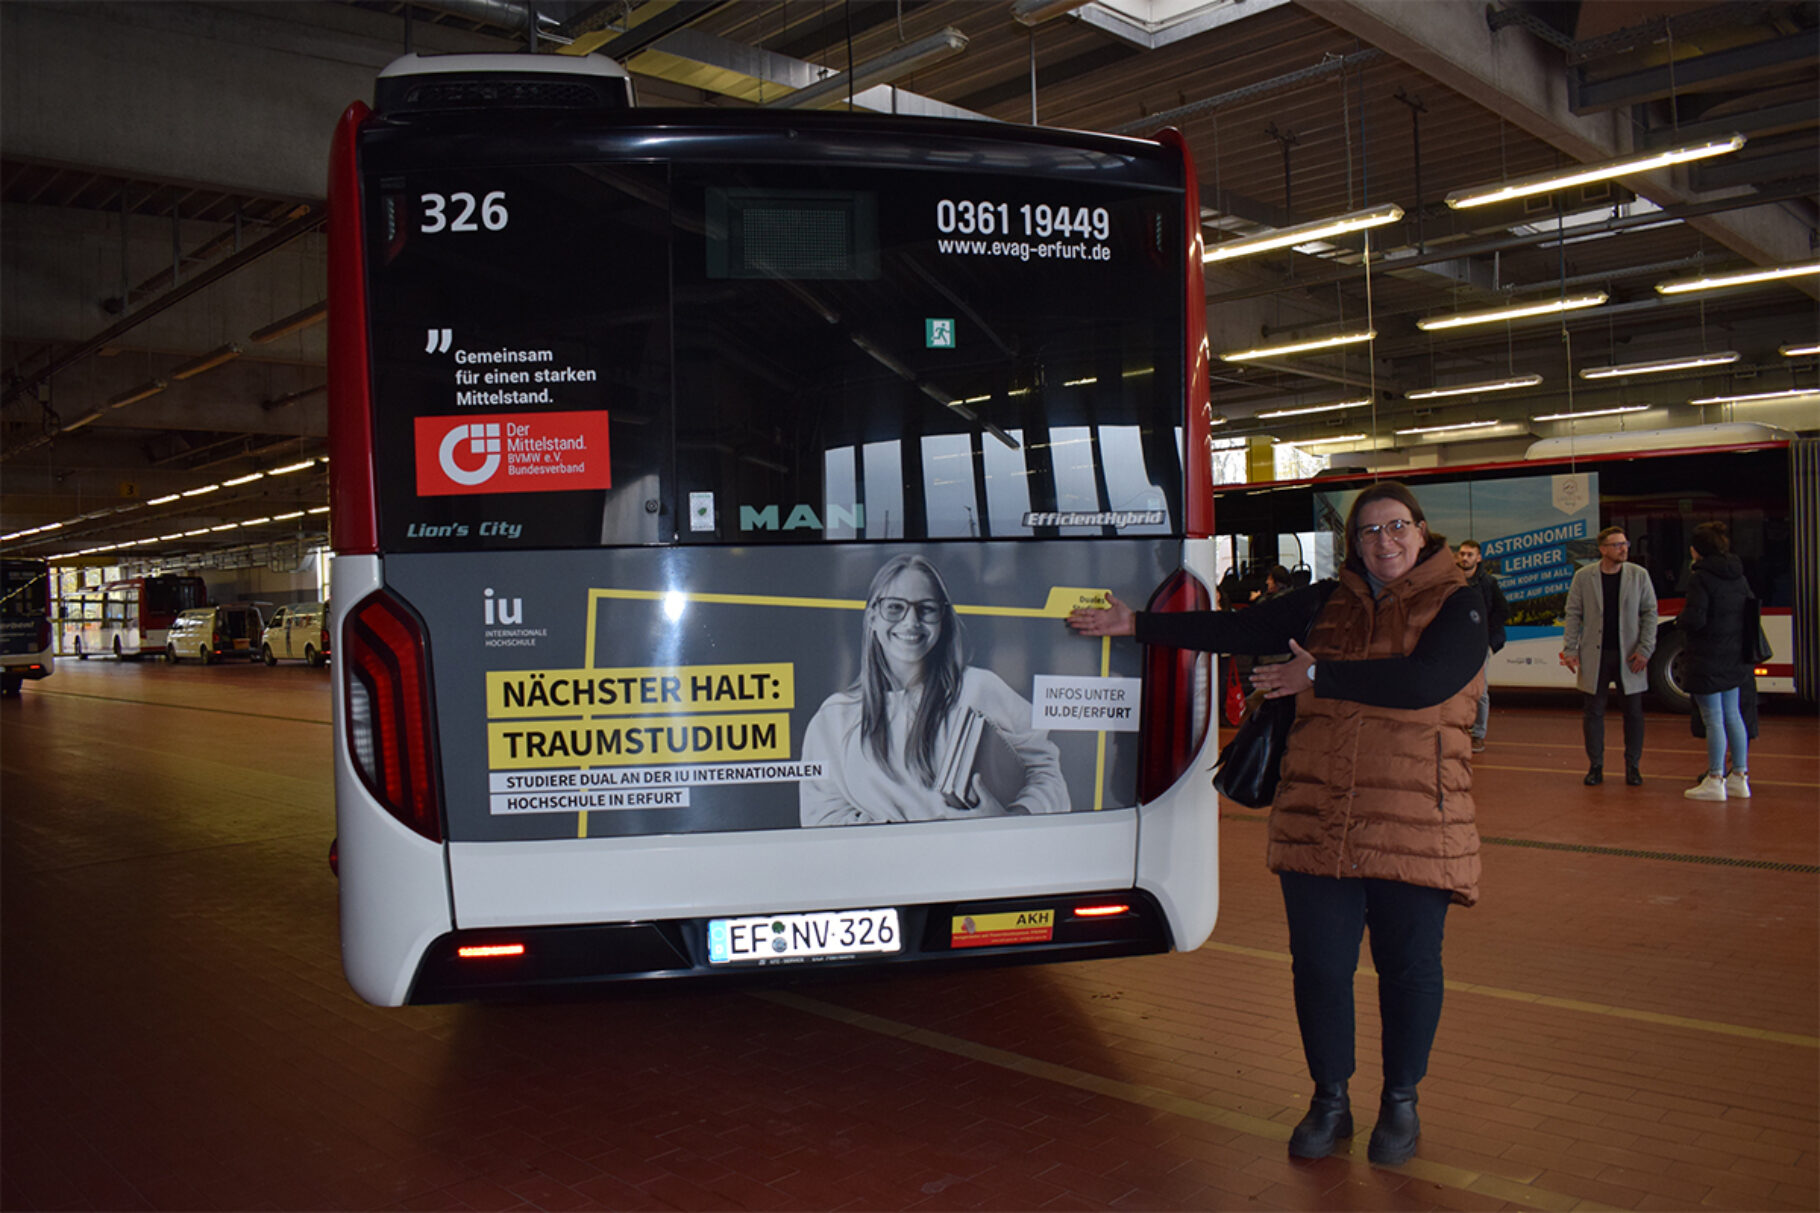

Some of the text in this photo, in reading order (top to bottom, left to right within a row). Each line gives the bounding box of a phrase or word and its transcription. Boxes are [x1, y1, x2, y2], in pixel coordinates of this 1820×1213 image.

[421, 191, 509, 233] 326
[937, 200, 1110, 240] 0361 19449
[938, 239, 1111, 261] www.evag-erfurt.de
[455, 348, 553, 364] Gemeinsam
[455, 367, 596, 385] für einen starken
[456, 388, 554, 406] Mittelstand.
[506, 422, 530, 437] Der
[507, 435, 587, 452] Mittelstand.
[508, 453, 540, 463] BVMW
[508, 463, 585, 475] Bundesverband
[739, 504, 865, 531] MAN
[1027, 511, 1163, 528] EfficientHybrid
[407, 521, 523, 539] Lion's City
[1484, 522, 1584, 557] ASTRONOMIE
[1505, 549, 1562, 572] LEHRER
[1518, 574, 1539, 584] KOPF
[1527, 588, 1543, 597] AUF
[1544, 583, 1563, 593] DEM
[484, 588, 522, 625] iu
[485, 629, 548, 638] INTERNATIONALE
[485, 639, 536, 647] HOCHSCHULE
[503, 673, 781, 708] NÄCHSTER HALT:
[1046, 687, 1126, 701] INFOS UNTER
[1045, 705, 1132, 719] IU.DE/ERFURT
[503, 723, 777, 759] TRAUMSTUDIUM
[507, 764, 822, 788] STUDIERE DUAL AN DER IU INTERNATIONALEN
[507, 791, 682, 810] HOCHSCHULE IN ERFURT
[1016, 912, 1049, 925] AKH
